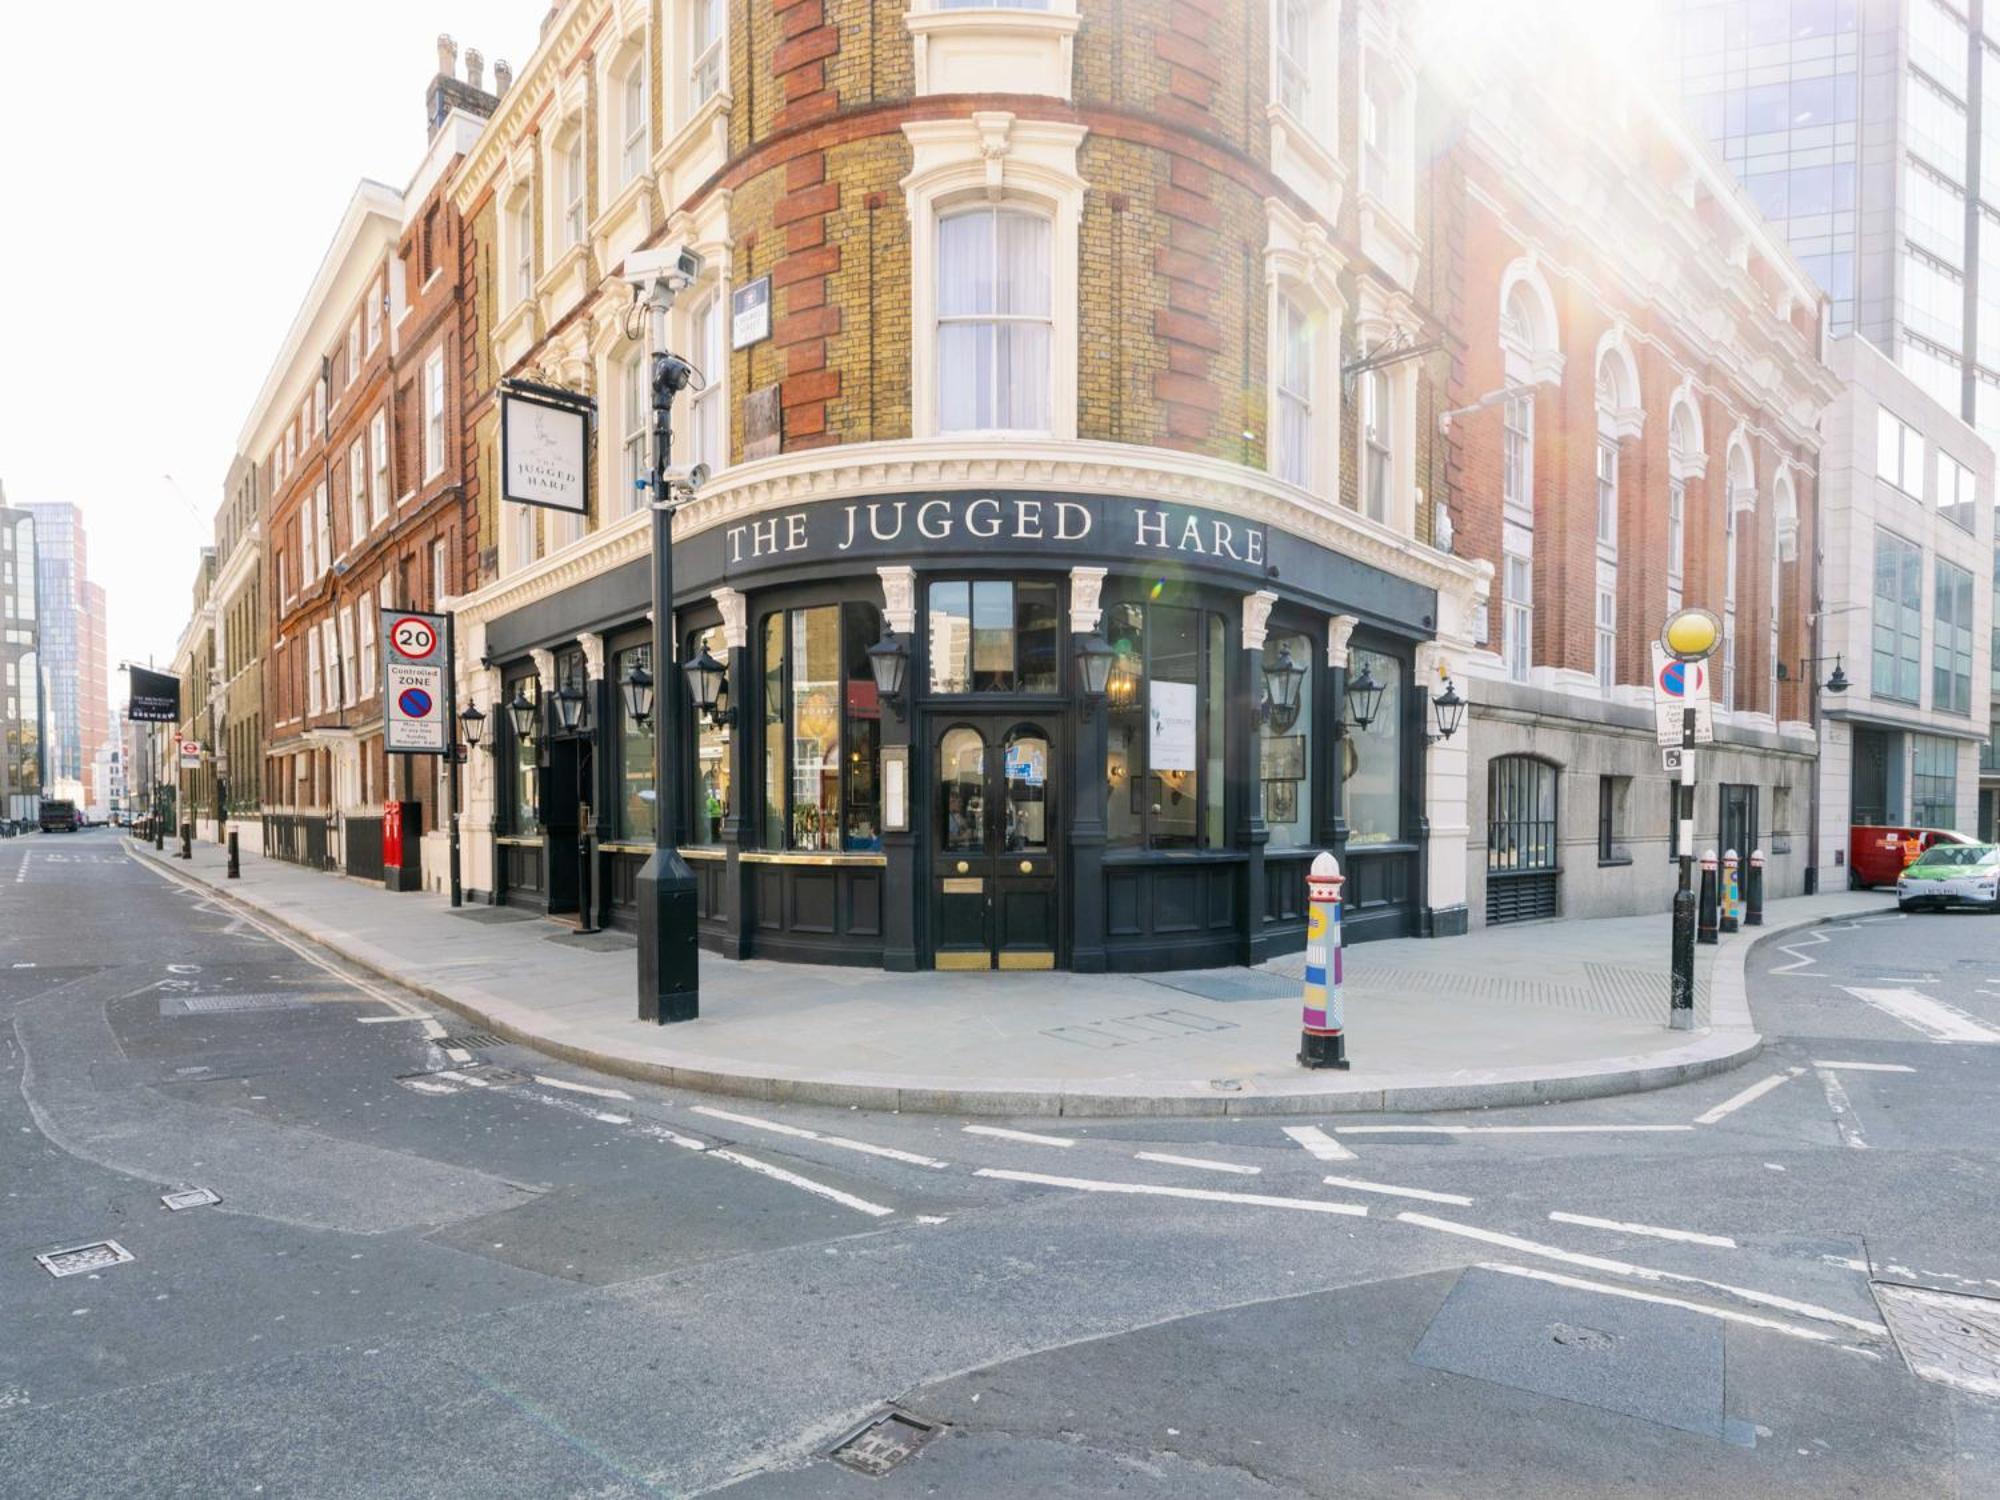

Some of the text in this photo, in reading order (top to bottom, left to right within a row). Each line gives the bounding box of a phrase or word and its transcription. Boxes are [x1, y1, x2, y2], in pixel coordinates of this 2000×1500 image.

[518, 462, 576, 483] JUGGED
[528, 476, 567, 492] HARE
[727, 498, 1264, 566] THE JUGGED HARE
[399, 628, 430, 648] 20
[391, 666, 438, 677] Controlled
[399, 676, 431, 687] ZONE
